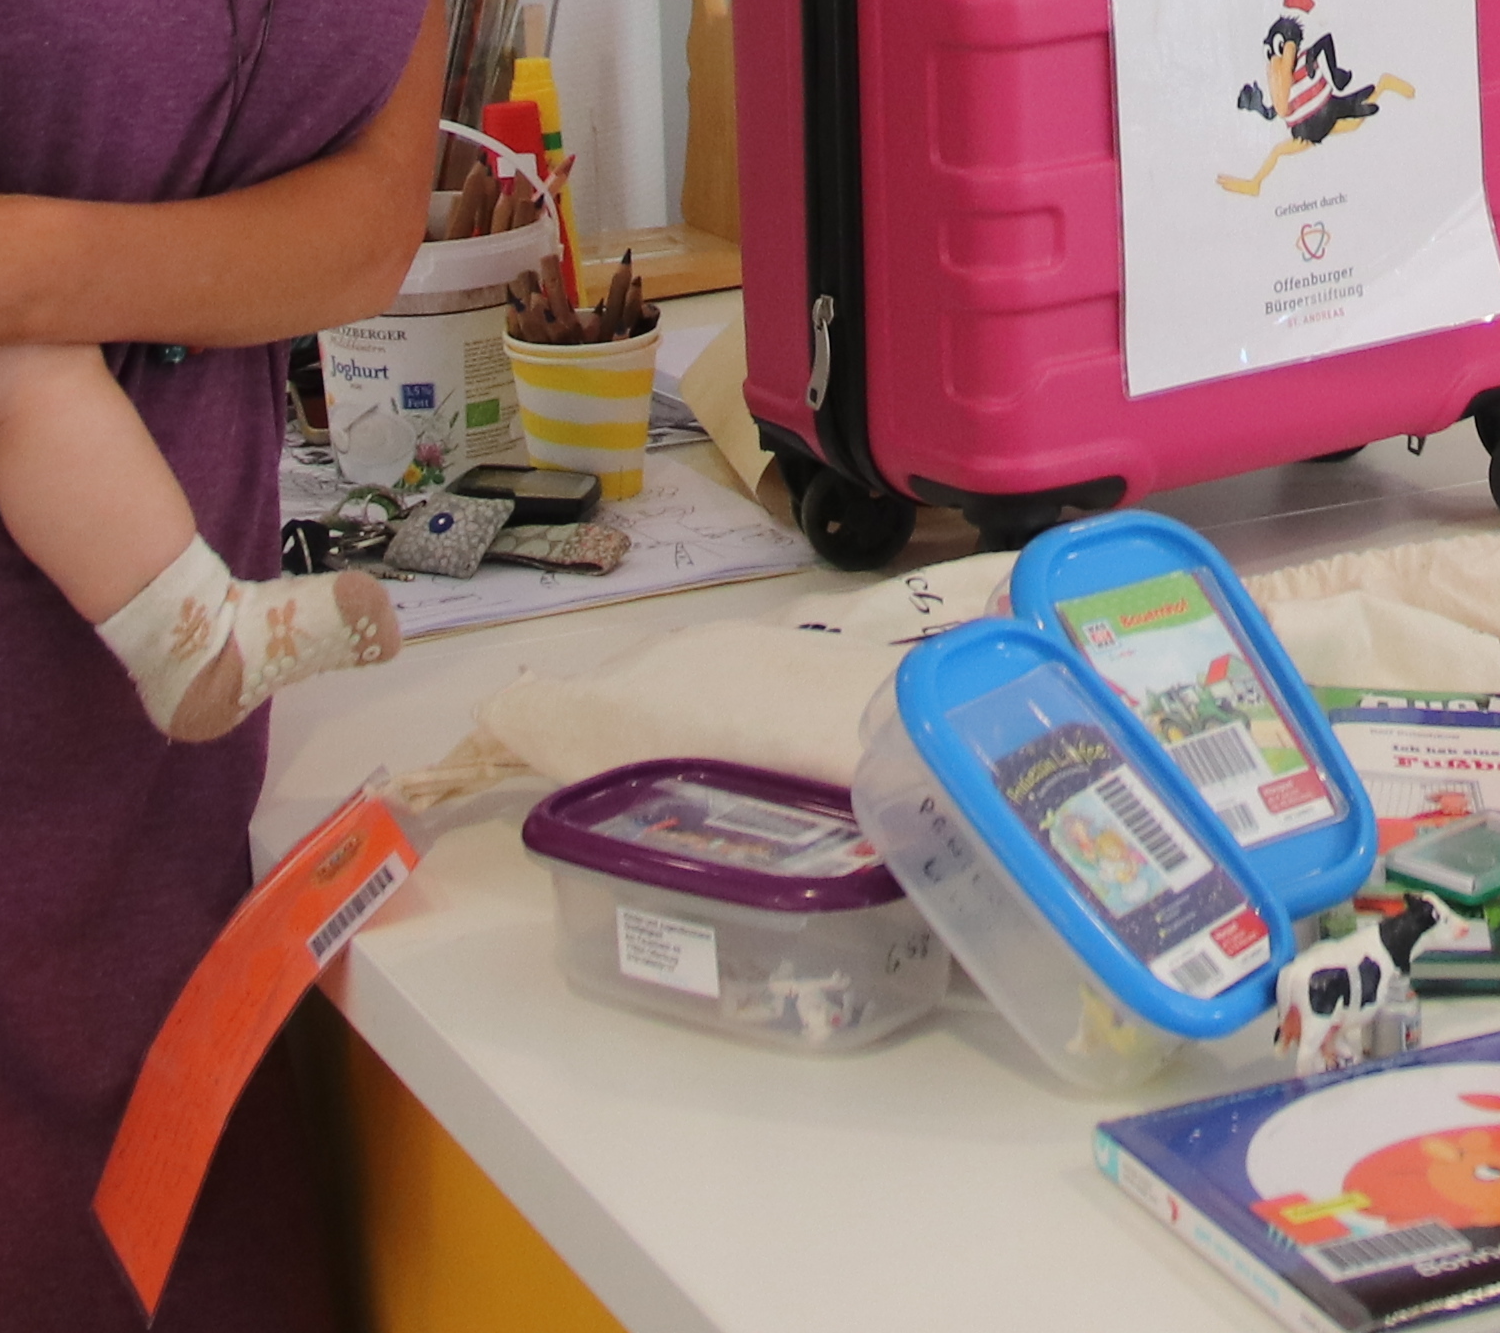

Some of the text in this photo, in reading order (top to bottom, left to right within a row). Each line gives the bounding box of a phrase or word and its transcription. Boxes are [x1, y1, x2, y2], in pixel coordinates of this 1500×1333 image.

[1274, 192, 1348, 218] Gefördert durch:
[1273, 267, 1355, 294] Offenburger
[1265, 283, 1365, 316] Bürgerstiftung
[1303, 307, 1346, 324] ANDREAS
[330, 355, 389, 382] Joghurt
[407, 397, 430, 409] Fett
[1119, 598, 1189, 629] Bauernhof
[1393, 744, 1423, 756] Ich
[1426, 744, 1461, 757] hab
